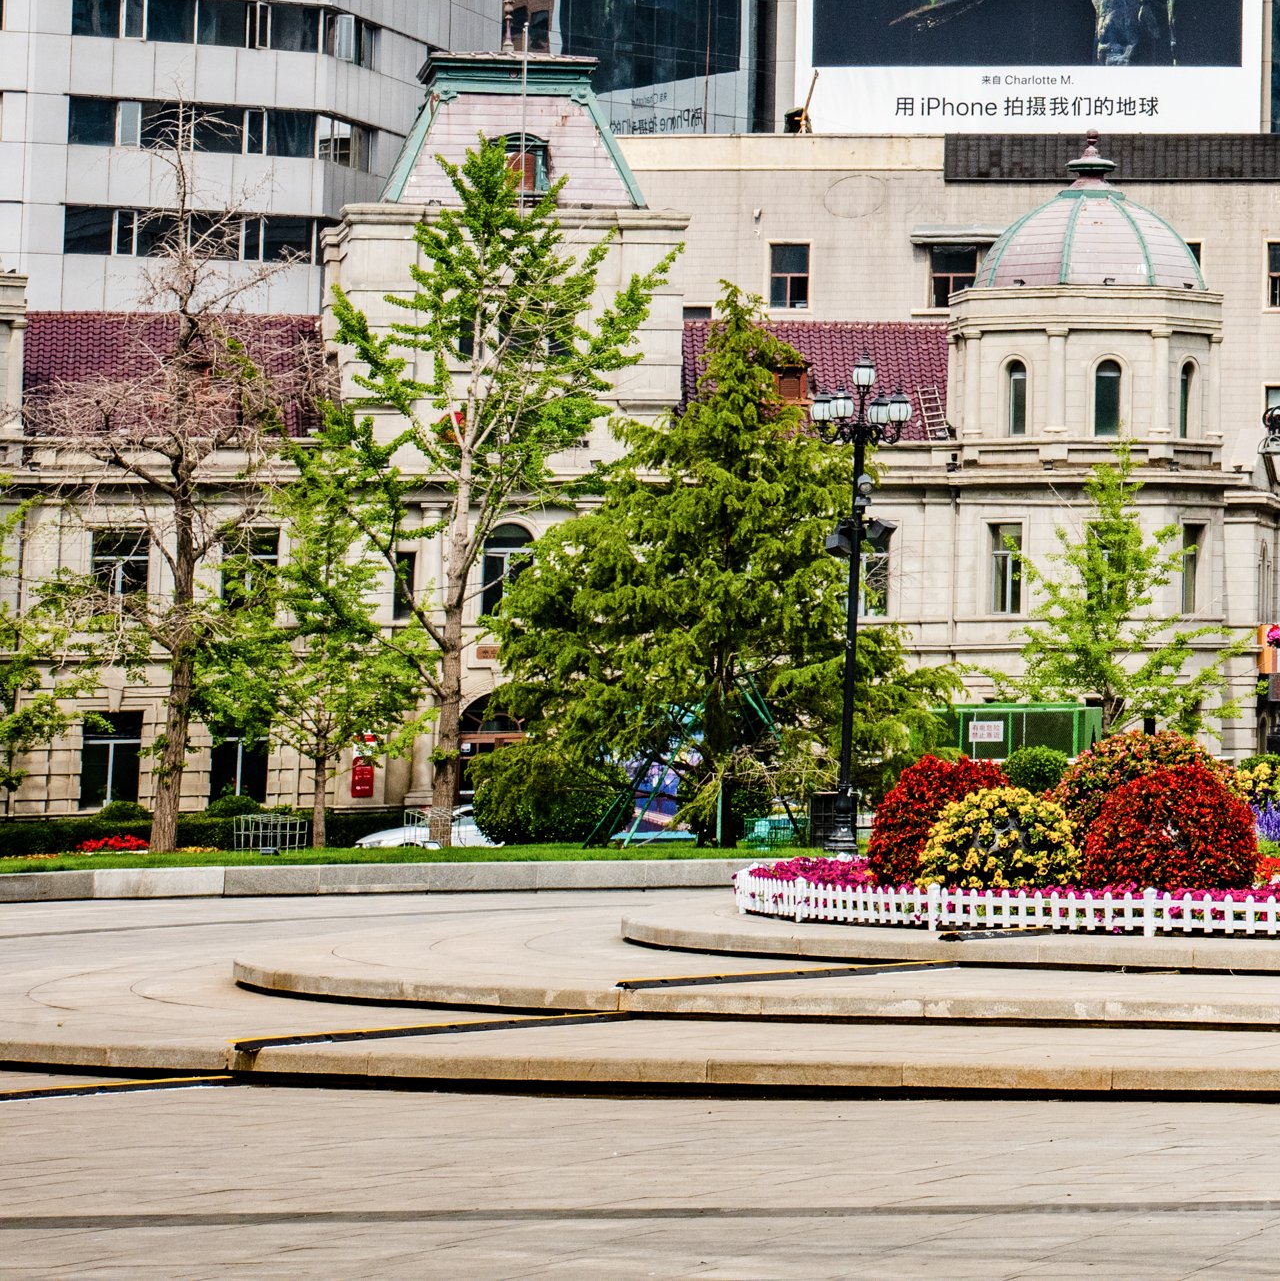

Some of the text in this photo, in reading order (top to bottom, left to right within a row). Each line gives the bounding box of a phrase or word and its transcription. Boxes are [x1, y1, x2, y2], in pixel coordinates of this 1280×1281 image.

[981, 75, 1075, 85] 来自 Charlotte M.
[895, 96, 1160, 117] 用 iPhone 拍摄我们的地球
